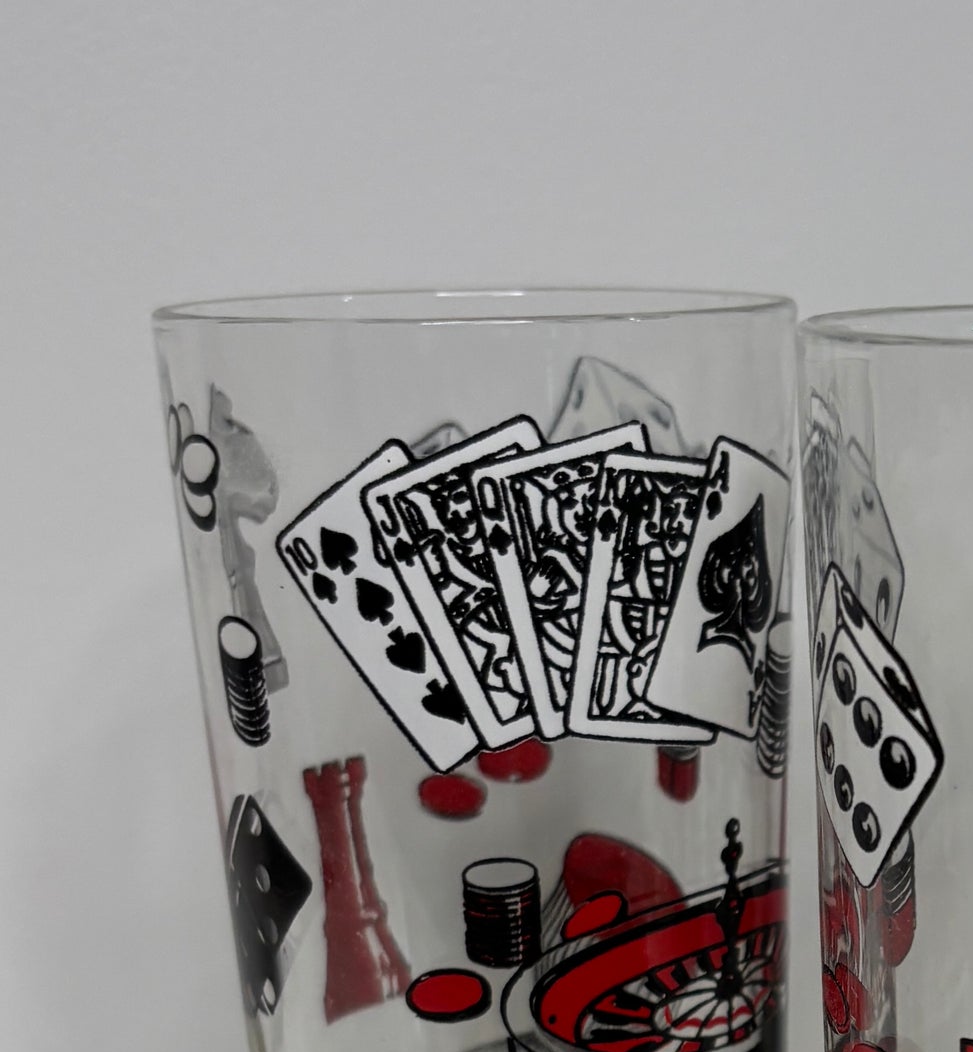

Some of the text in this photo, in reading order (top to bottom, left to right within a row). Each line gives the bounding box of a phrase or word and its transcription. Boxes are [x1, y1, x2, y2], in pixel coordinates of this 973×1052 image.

[709, 450, 730, 494] A
[376, 494, 400, 537] J
[285, 537, 318, 576] 10
